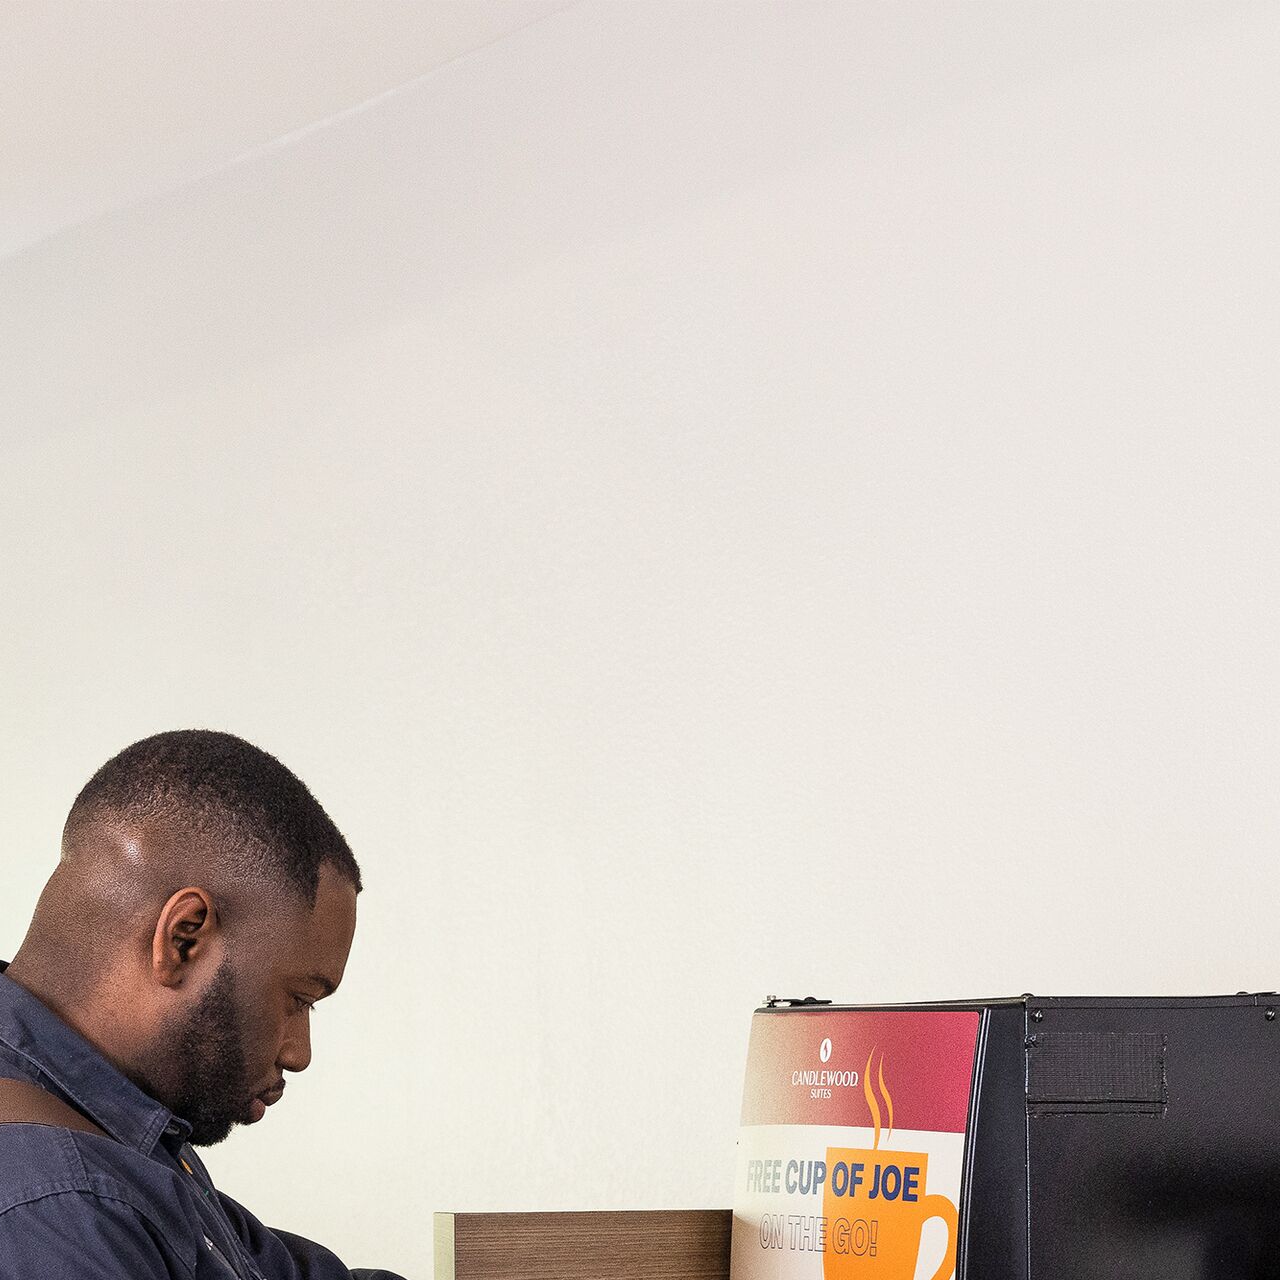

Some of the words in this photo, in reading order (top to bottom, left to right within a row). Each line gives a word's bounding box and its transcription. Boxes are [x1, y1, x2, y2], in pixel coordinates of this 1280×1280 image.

[792, 1070, 859, 1087] CANDLEWOOD
[810, 1088, 832, 1099] SUITES
[746, 1160, 782, 1193] FREE
[785, 1159, 827, 1195] CUP
[831, 1161, 865, 1197] OF
[868, 1164, 920, 1202] JOE
[759, 1213, 784, 1250] ON
[788, 1215, 828, 1253] THE
[832, 1217, 879, 1257] GO!
